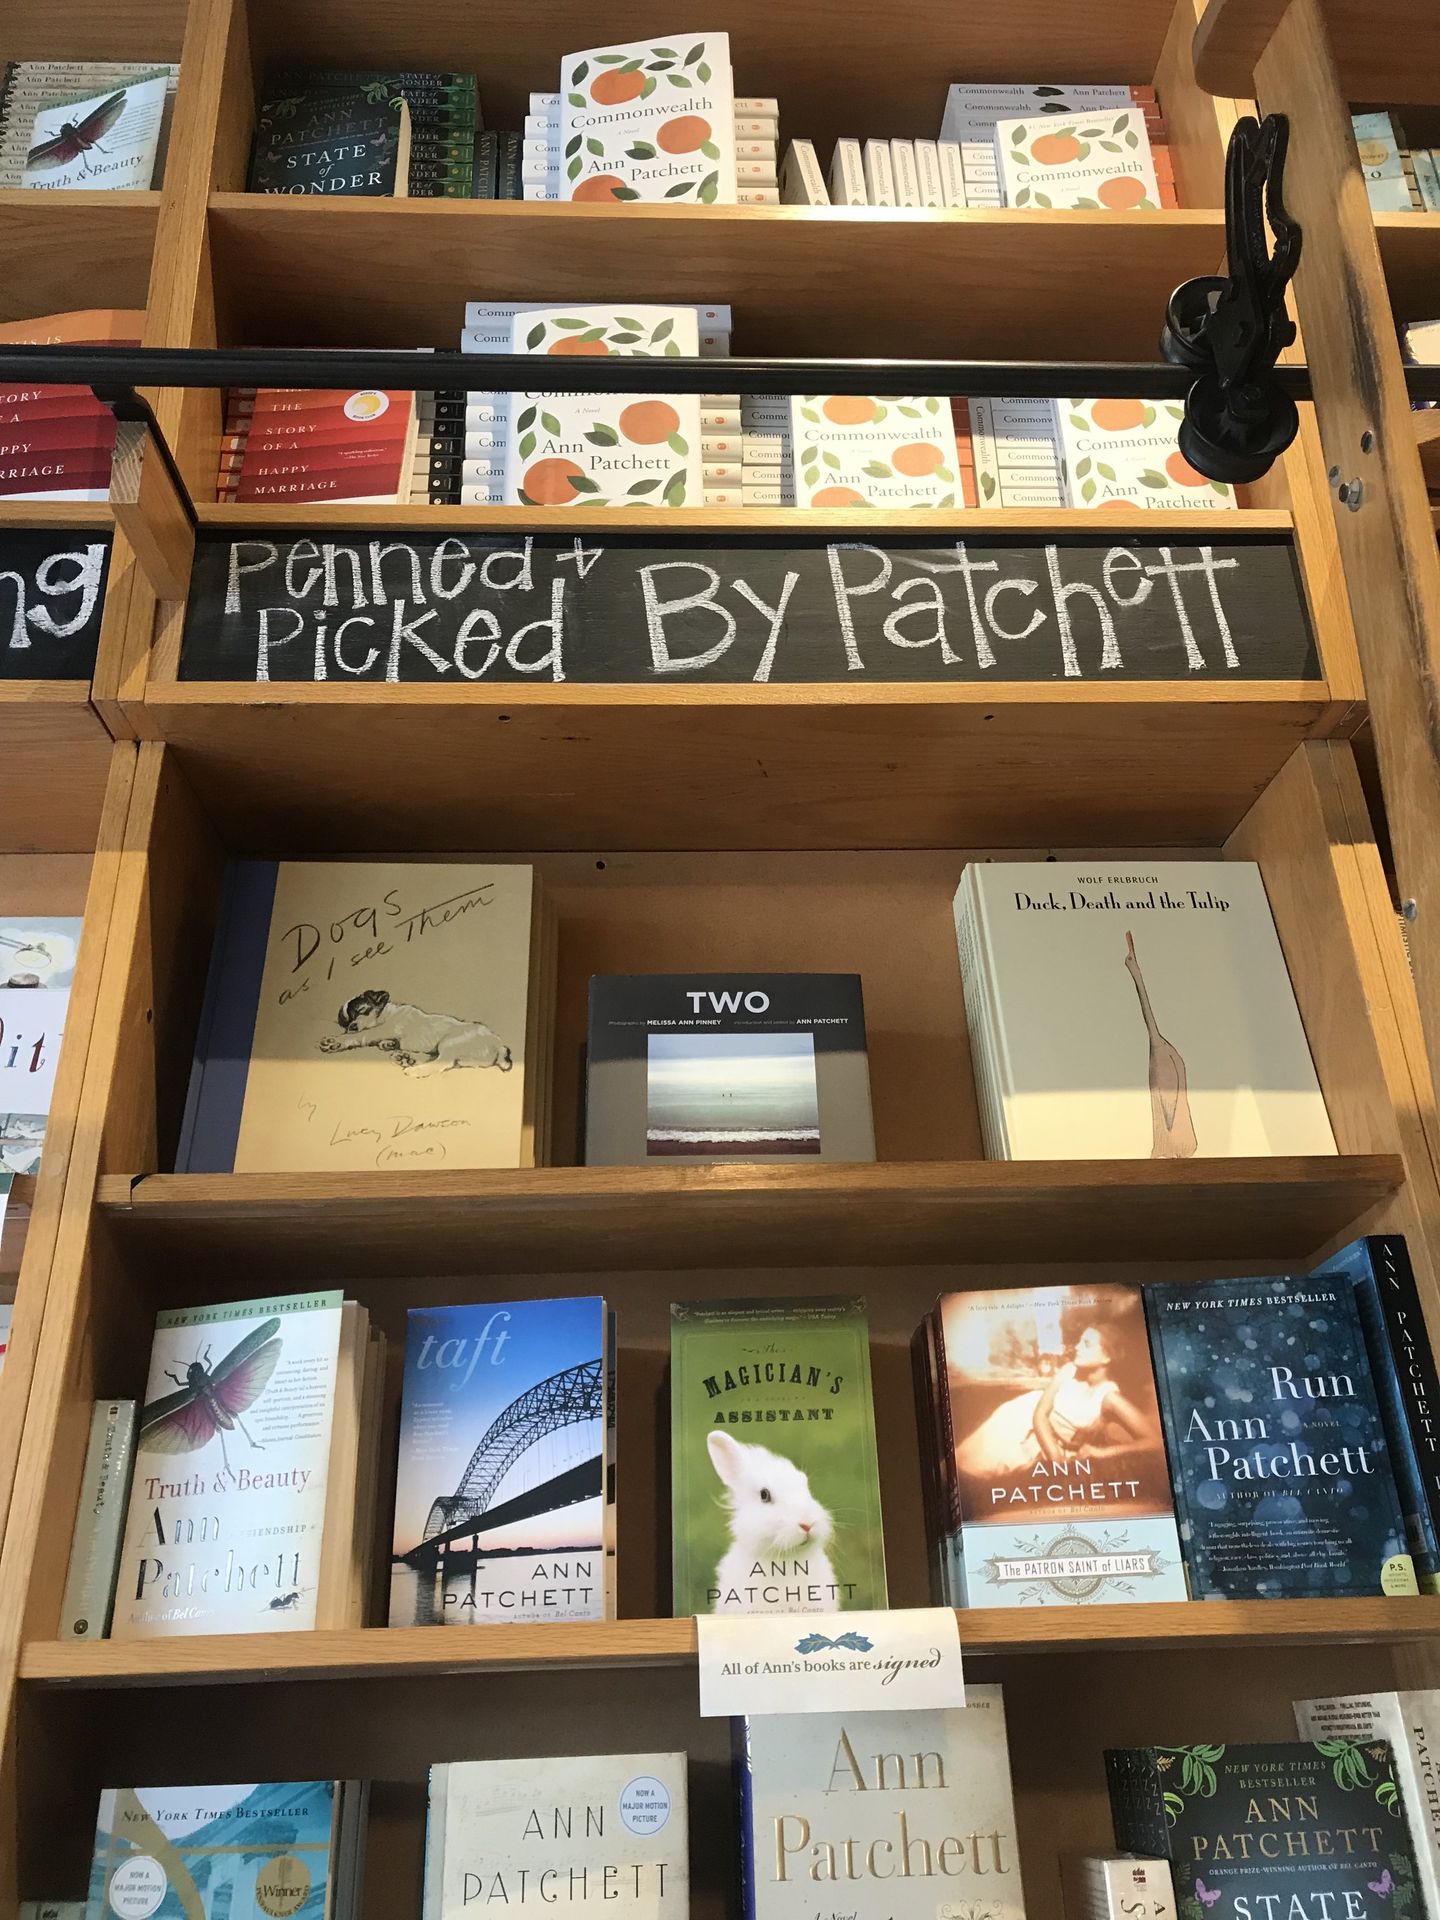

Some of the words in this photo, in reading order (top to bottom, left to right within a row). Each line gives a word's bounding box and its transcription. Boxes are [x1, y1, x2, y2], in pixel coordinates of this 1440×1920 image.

[958, 87, 1025, 96] Commonwealth
[1072, 88, 1090, 96] Ann
[1091, 88, 1126, 97] Patchett
[308, 110, 352, 126] ANN
[571, 97, 713, 129] Commonwealth
[964, 102, 1031, 112] Commonwealth
[272, 117, 388, 144] PATCHETT
[287, 145, 366, 168] STATE
[588, 159, 625, 173] Ann
[30, 175, 71, 190] Truth
[77, 169, 88, 181] &
[93, 154, 144, 176] Beauty
[319, 164, 335, 177] of
[631, 161, 704, 182] Patchett
[1016, 161, 1143, 184] Commonwealth
[271, 403, 303, 412] THE
[266, 425, 318, 435] STORY
[804, 427, 942, 441] Commonwealth
[976, 406, 991, 465] Commonwealth
[263, 442, 283, 451] OF
[289, 442, 299, 450] A
[542, 440, 584, 454] Ann
[258, 465, 310, 476] HAPPY
[590, 455, 670, 470] Patchett
[254, 480, 338, 494] MARRIAGE
[824, 472, 861, 484] Ann
[867, 484, 938, 497] Patchett
[1101, 484, 1138, 498] Ann
[1145, 494, 1216, 509] Patchett
[225, 535, 534, 614] Penned
[638, 561, 799, 682] By
[827, 540, 1239, 677] Patchett
[257, 578, 567, 683] Picked
[1107, 876, 1158, 884] ERLBRUCH
[1014, 892, 1067, 911] Duck,
[1071, 892, 1121, 910] Death
[1126, 892, 1155, 909] and
[1160, 892, 1185, 909] the
[1186, 891, 1230, 911] Tulip
[281, 890, 401, 974] Dogs
[279, 979, 311, 1005] as
[327, 957, 335, 980] I
[351, 941, 394, 967] see
[395, 884, 494, 942] Them
[686, 991, 770, 1014] TWO
[297, 1095, 317, 1122] by
[330, 1121, 382, 1146] Lucy
[390, 1116, 471, 1139] Dawson
[166, 1315, 188, 1326] NEW
[193, 1313, 217, 1323] YORK
[223, 1308, 253, 1319] TIMES
[259, 1299, 327, 1314] BESTSELLER
[1166, 1302, 1190, 1311] NEW
[1195, 1300, 1224, 1310] YORK
[1228, 1297, 1262, 1307] TIMES
[1267, 1293, 1336, 1305] BESTSELLER
[417, 1312, 511, 1392] taft
[1382, 1244, 1400, 1290] ANN
[1397, 1311, 1438, 1452] PATCHETT
[702, 1362, 844, 1398] MAGICIAN'S
[1267, 1366, 1358, 1400] Run
[714, 1407, 834, 1424] ASSISTANT
[1184, 1408, 1269, 1443] Ann
[1312, 1420, 1341, 1428] NOVEL
[1032, 1459, 1091, 1477] ANN
[1204, 1443, 1374, 1481] Patchett
[145, 1474, 205, 1500] Truth
[213, 1472, 226, 1492] &
[238, 1469, 311, 1493] Beauty
[991, 1481, 1140, 1504] PATCHETT
[139, 1506, 219, 1548] Ann
[136, 1550, 300, 1600] Patchett
[532, 1561, 591, 1580] ANN
[749, 1560, 809, 1578] ANN
[1004, 1564, 1021, 1576] The
[1025, 1560, 1064, 1575] PATRON
[1069, 1559, 1098, 1573] SAINT
[1102, 1558, 1112, 1572] of
[1115, 1557, 1145, 1571] LIARS
[443, 1588, 593, 1610] PATCHETT
[707, 1584, 858, 1605] PATCHETT
[721, 1662, 741, 1676] All
[745, 1662, 761, 1675] of
[762, 1660, 800, 1673] Ann's
[805, 1658, 846, 1672] books
[849, 1660, 871, 1671] are
[873, 1647, 944, 1686] signed
[822, 1726, 950, 1793] Ann
[1224, 1764, 1250, 1774] NEW
[1254, 1763, 1285, 1772] YORK
[1290, 1761, 1327, 1771] TIMES
[1239, 1777, 1317, 1789] BESTSELLER
[122, 1810, 151, 1822] NEW
[156, 1809, 188, 1821] YORK
[195, 1808, 232, 1820] TIMES
[236, 1806, 310, 1819] BESTSELLER
[622, 1801, 643, 1810] MAJOR
[645, 1801, 668, 1810] MOTION
[1245, 1796, 1320, 1823] ANN
[522, 1805, 604, 1841] ANN
[769, 1809, 1011, 1882] Patchett
[1192, 1828, 1382, 1860] PATCHETT
[1209, 1867, 1238, 1876] ORANGE
[1240, 1865, 1295, 1875] PRIZE-WINNING
[1298, 1864, 1326, 1873] AUTHOR
[1339, 1863, 1352, 1871] BEL
[1354, 1862, 1377, 1870] CANTO
[263, 1886, 302, 1897] Winner
[464, 1863, 668, 1906] PATCHETT
[1234, 1891, 1366, 1920] STATE
